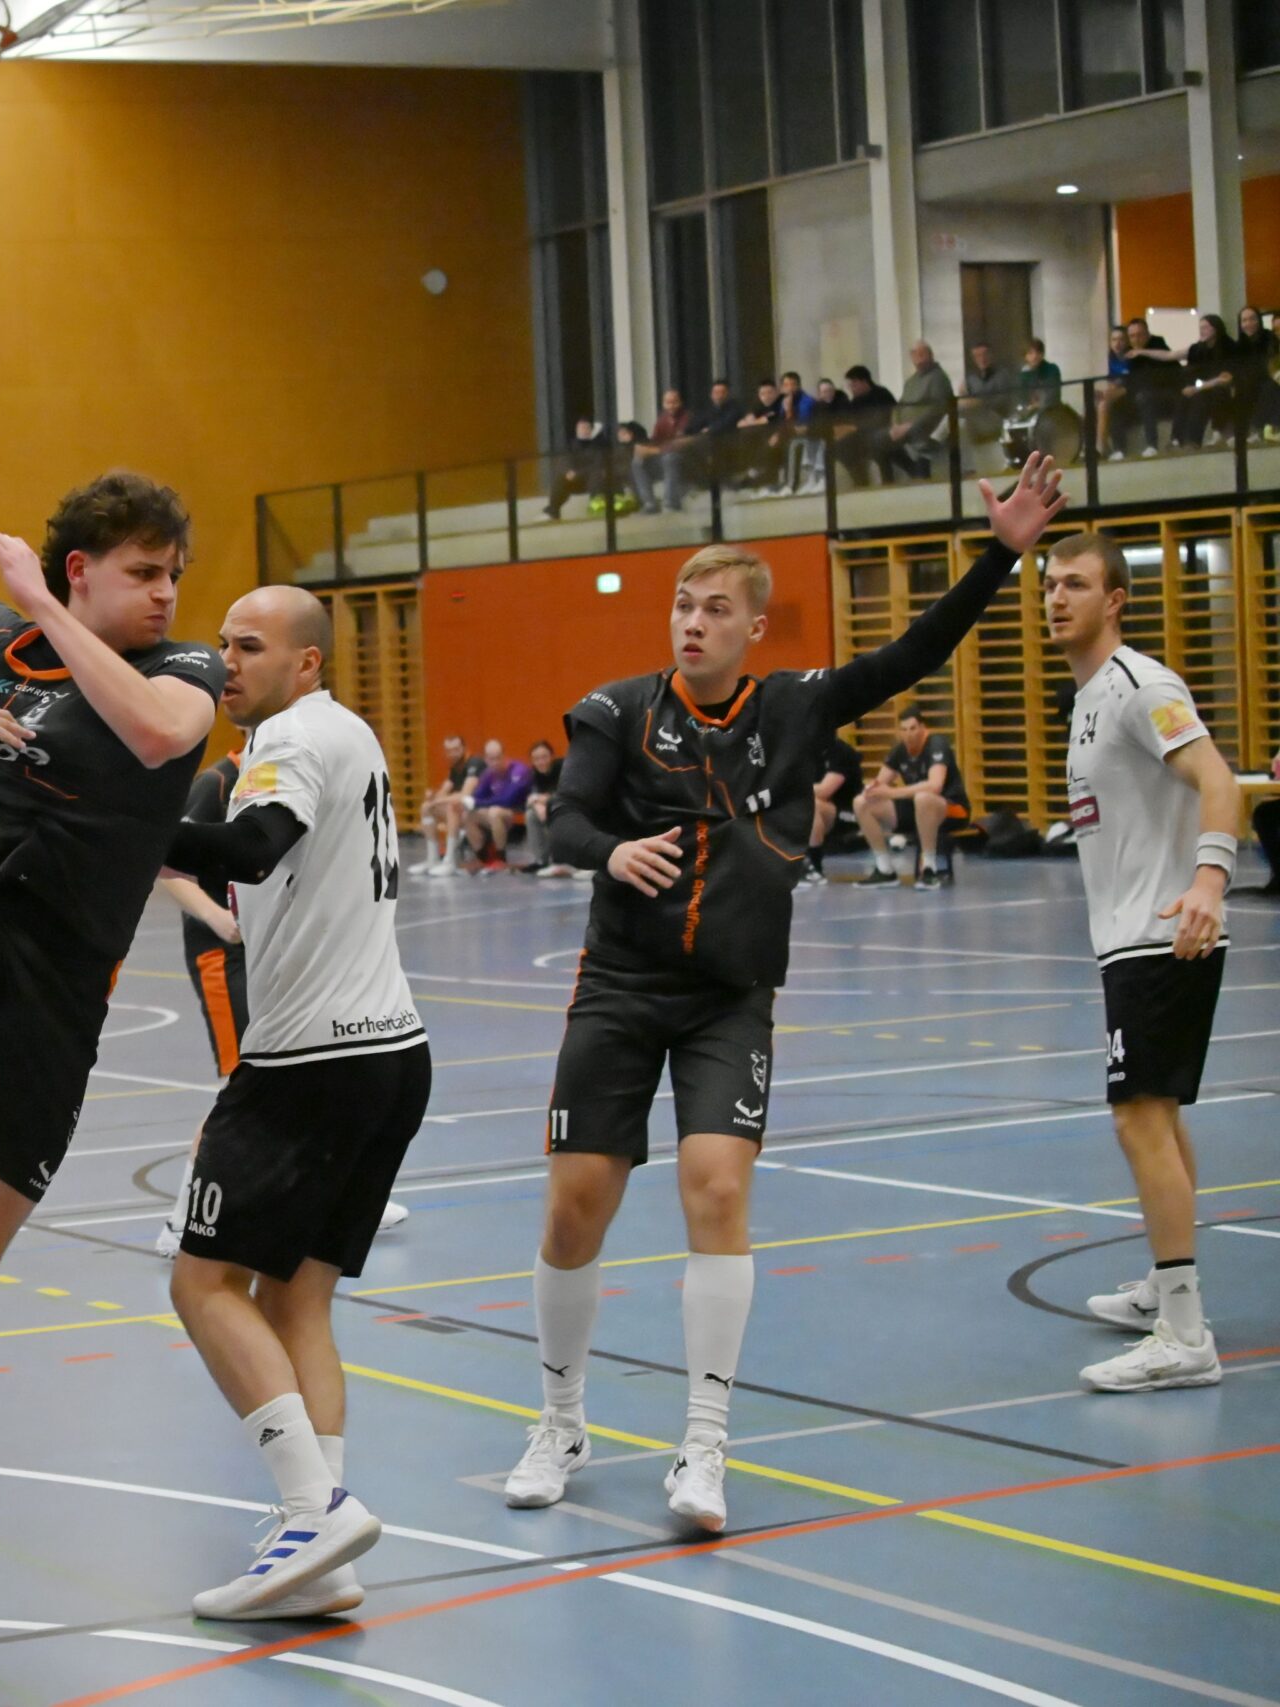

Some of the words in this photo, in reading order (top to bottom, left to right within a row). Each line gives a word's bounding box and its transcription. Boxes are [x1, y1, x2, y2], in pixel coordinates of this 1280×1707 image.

[551, 1109, 569, 1140] 11
[732, 1116, 763, 1130] HARWY
[191, 1176, 223, 1226] 10
[187, 1220, 217, 1238] JAKO
